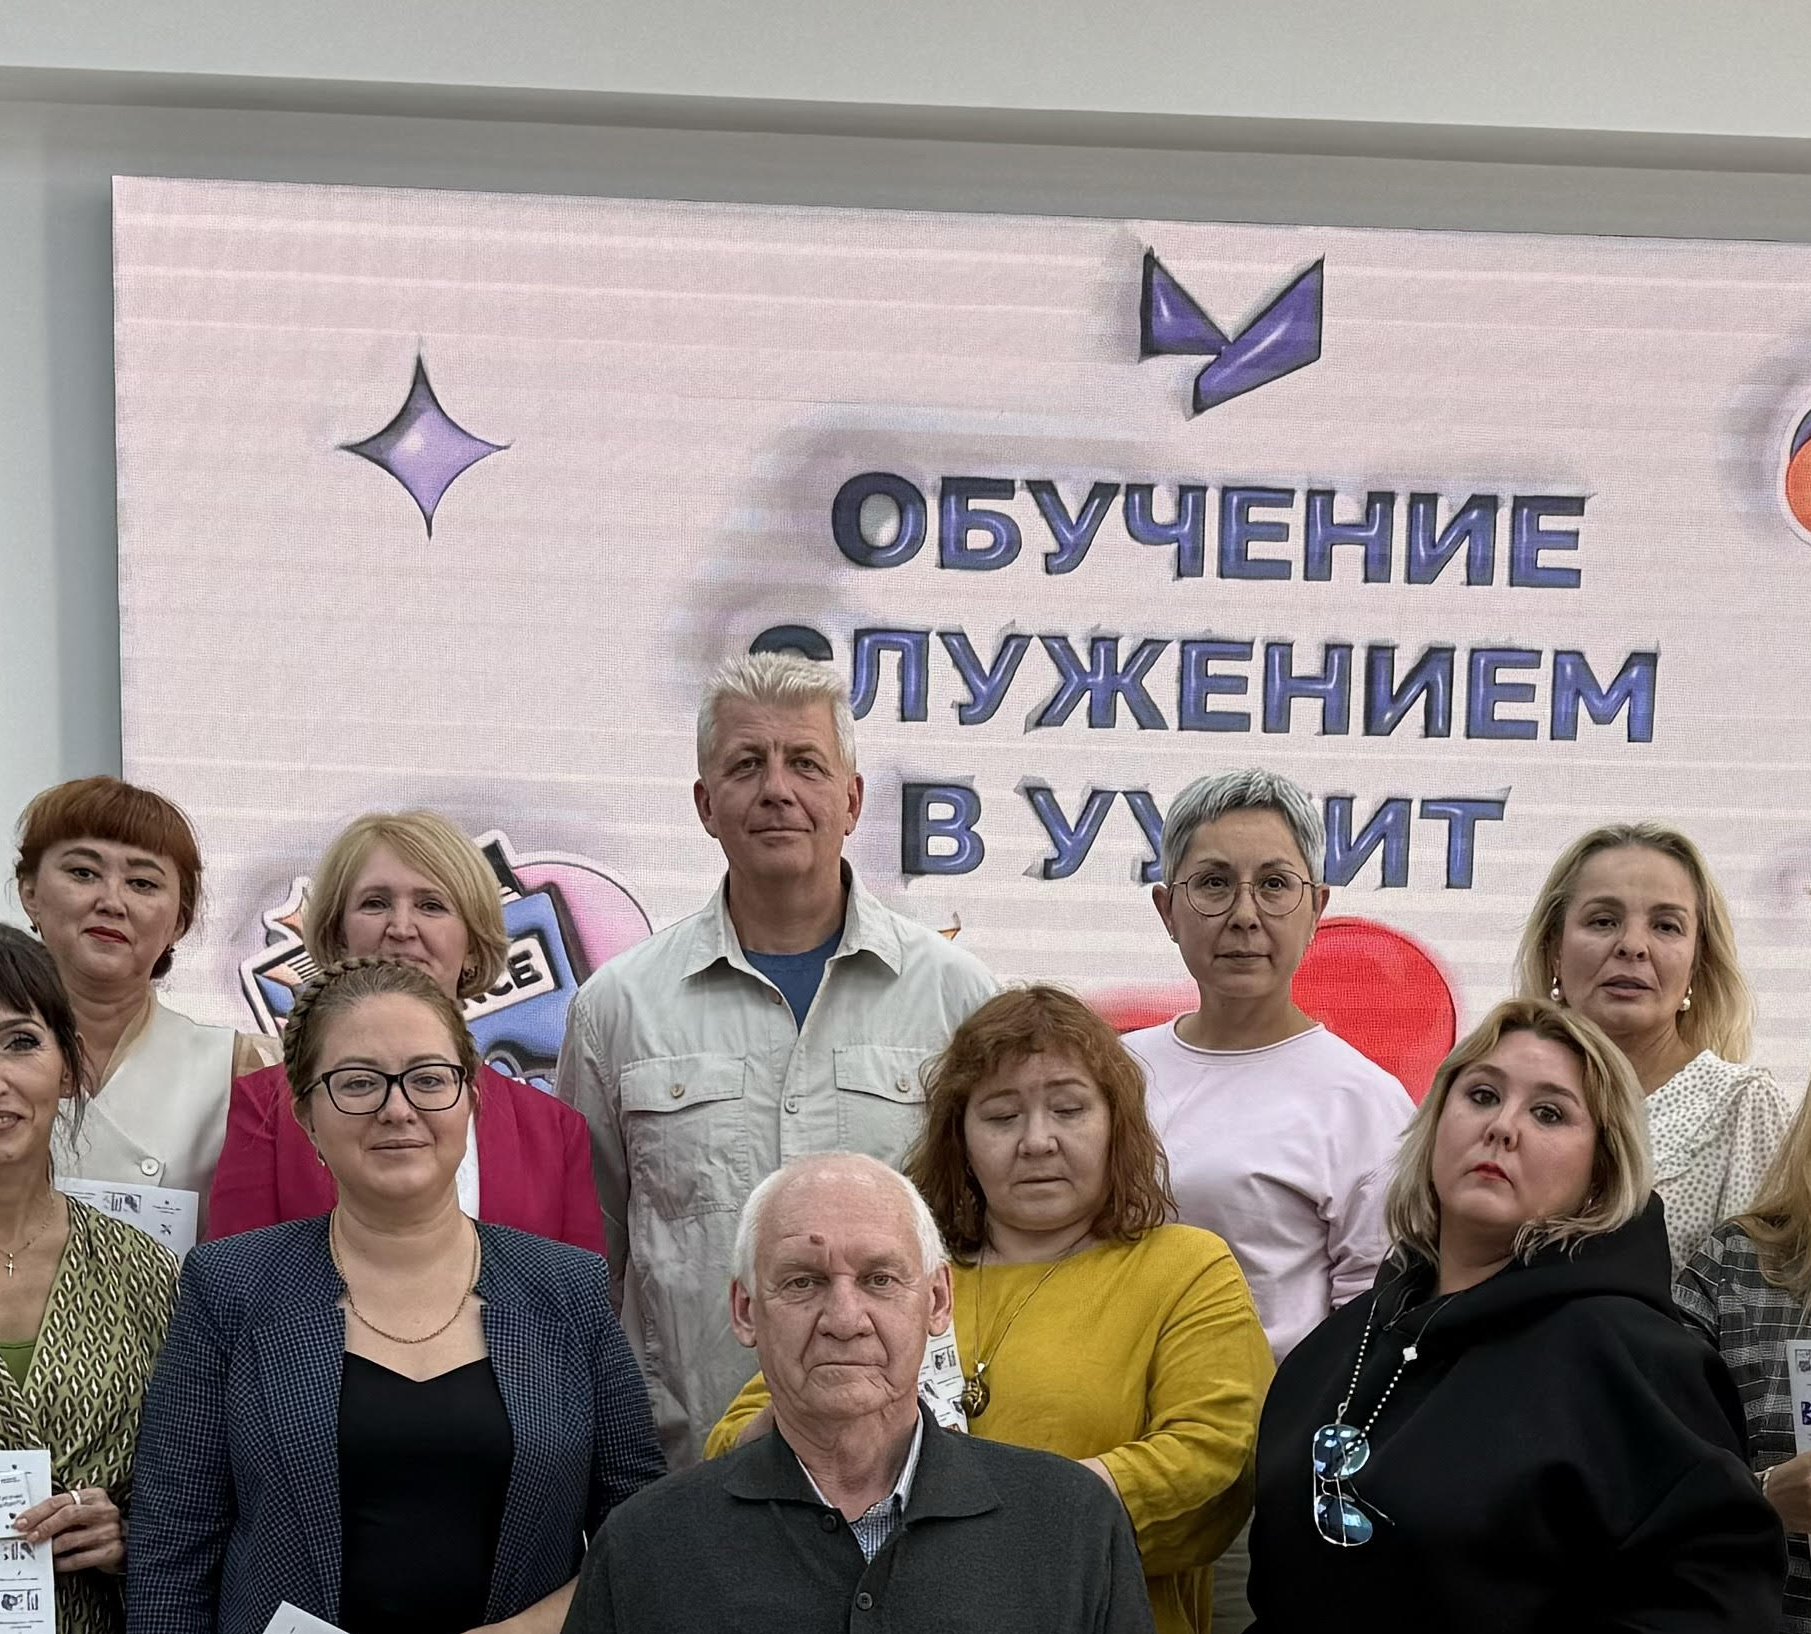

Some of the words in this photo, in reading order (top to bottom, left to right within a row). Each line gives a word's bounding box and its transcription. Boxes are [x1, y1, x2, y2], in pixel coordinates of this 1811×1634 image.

[830, 470, 1587, 589] ОБУЧЕНИЕ
[900, 780, 985, 878] В
[1023, 784, 1508, 891] УИТ
